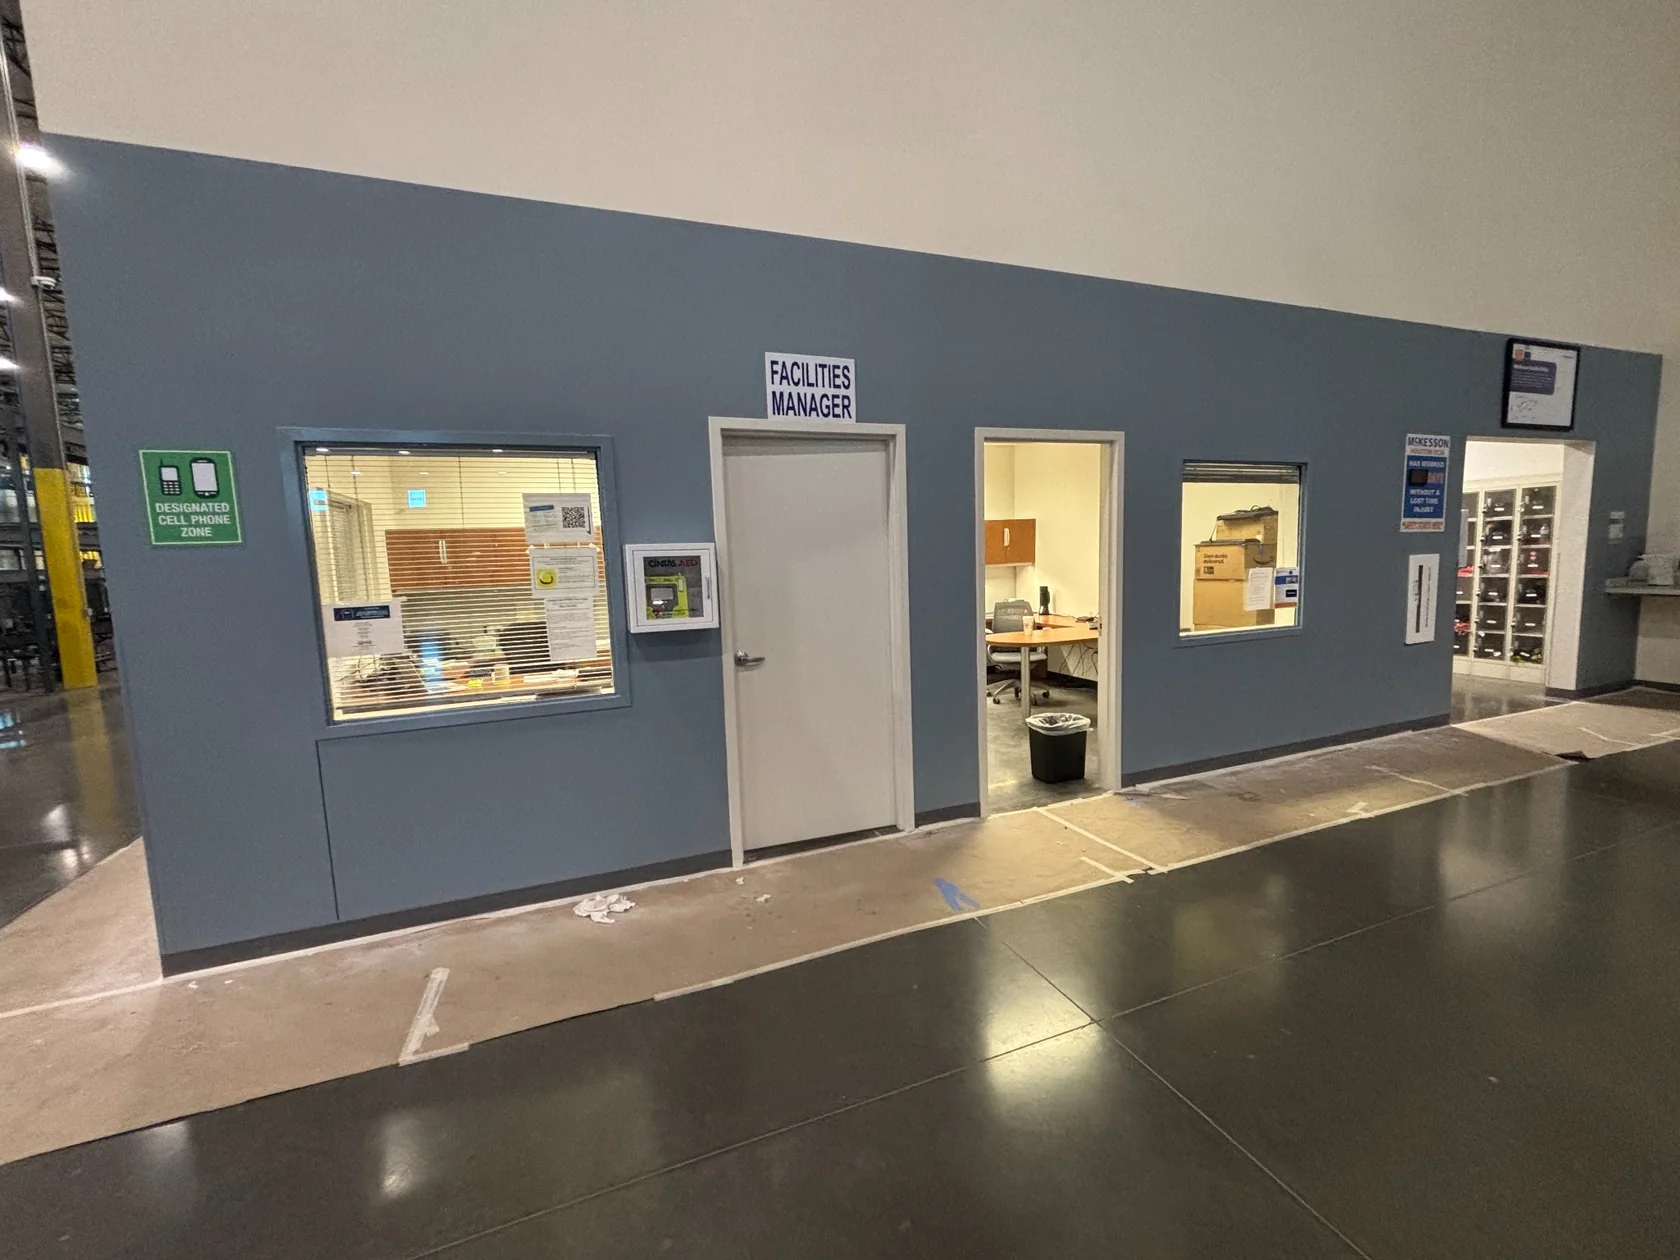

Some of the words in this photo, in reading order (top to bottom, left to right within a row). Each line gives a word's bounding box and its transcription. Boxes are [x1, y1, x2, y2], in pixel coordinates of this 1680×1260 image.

[770, 360, 851, 390] FACILITIES
[771, 390, 852, 419] MANAGER
[155, 503, 229, 513] DESIGNATED
[158, 514, 188, 525] CELL
[191, 514, 231, 525] PHONE
[181, 527, 212, 537] ZONE
[679, 559, 698, 567] AED
